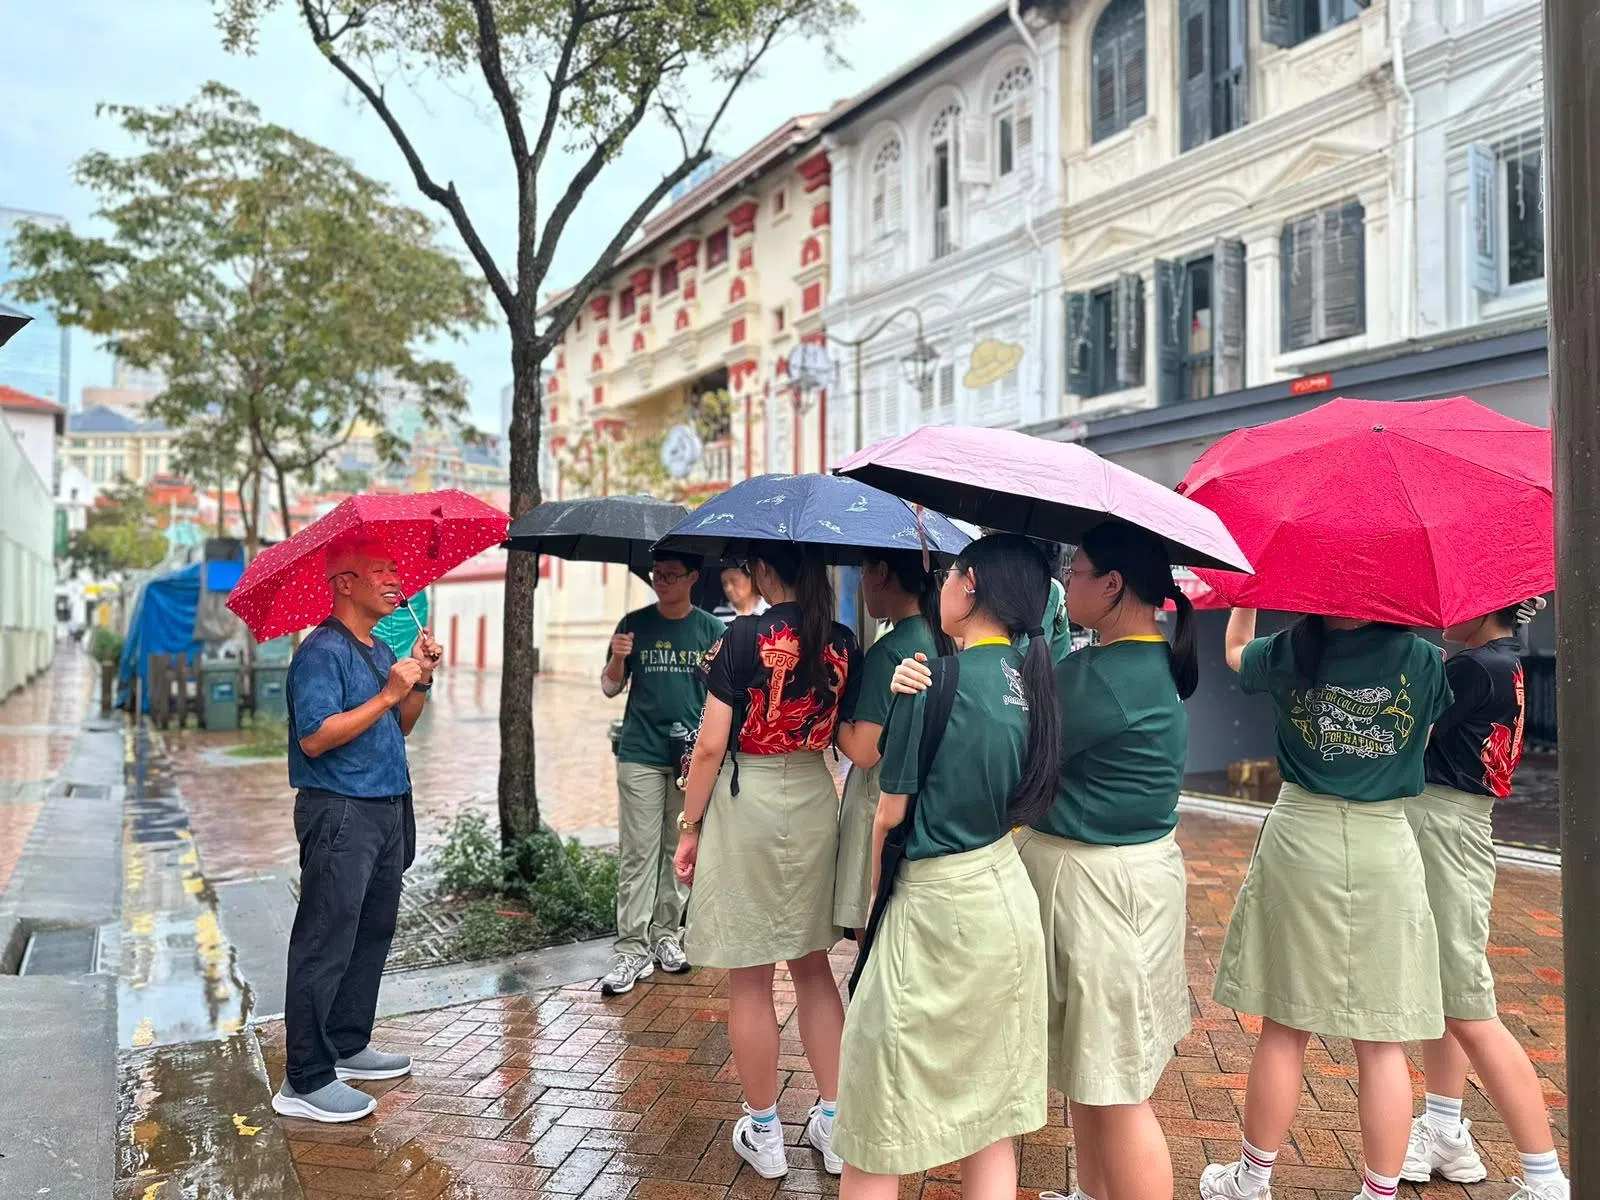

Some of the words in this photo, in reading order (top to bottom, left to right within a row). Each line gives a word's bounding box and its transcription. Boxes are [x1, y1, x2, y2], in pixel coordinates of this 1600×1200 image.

[765, 652, 797, 669] TJC
[1320, 688, 1337, 704] FOR
[1336, 695, 1377, 716] COLLEGE
[1325, 731, 1341, 743] FOR
[1343, 733, 1384, 753] NATION
